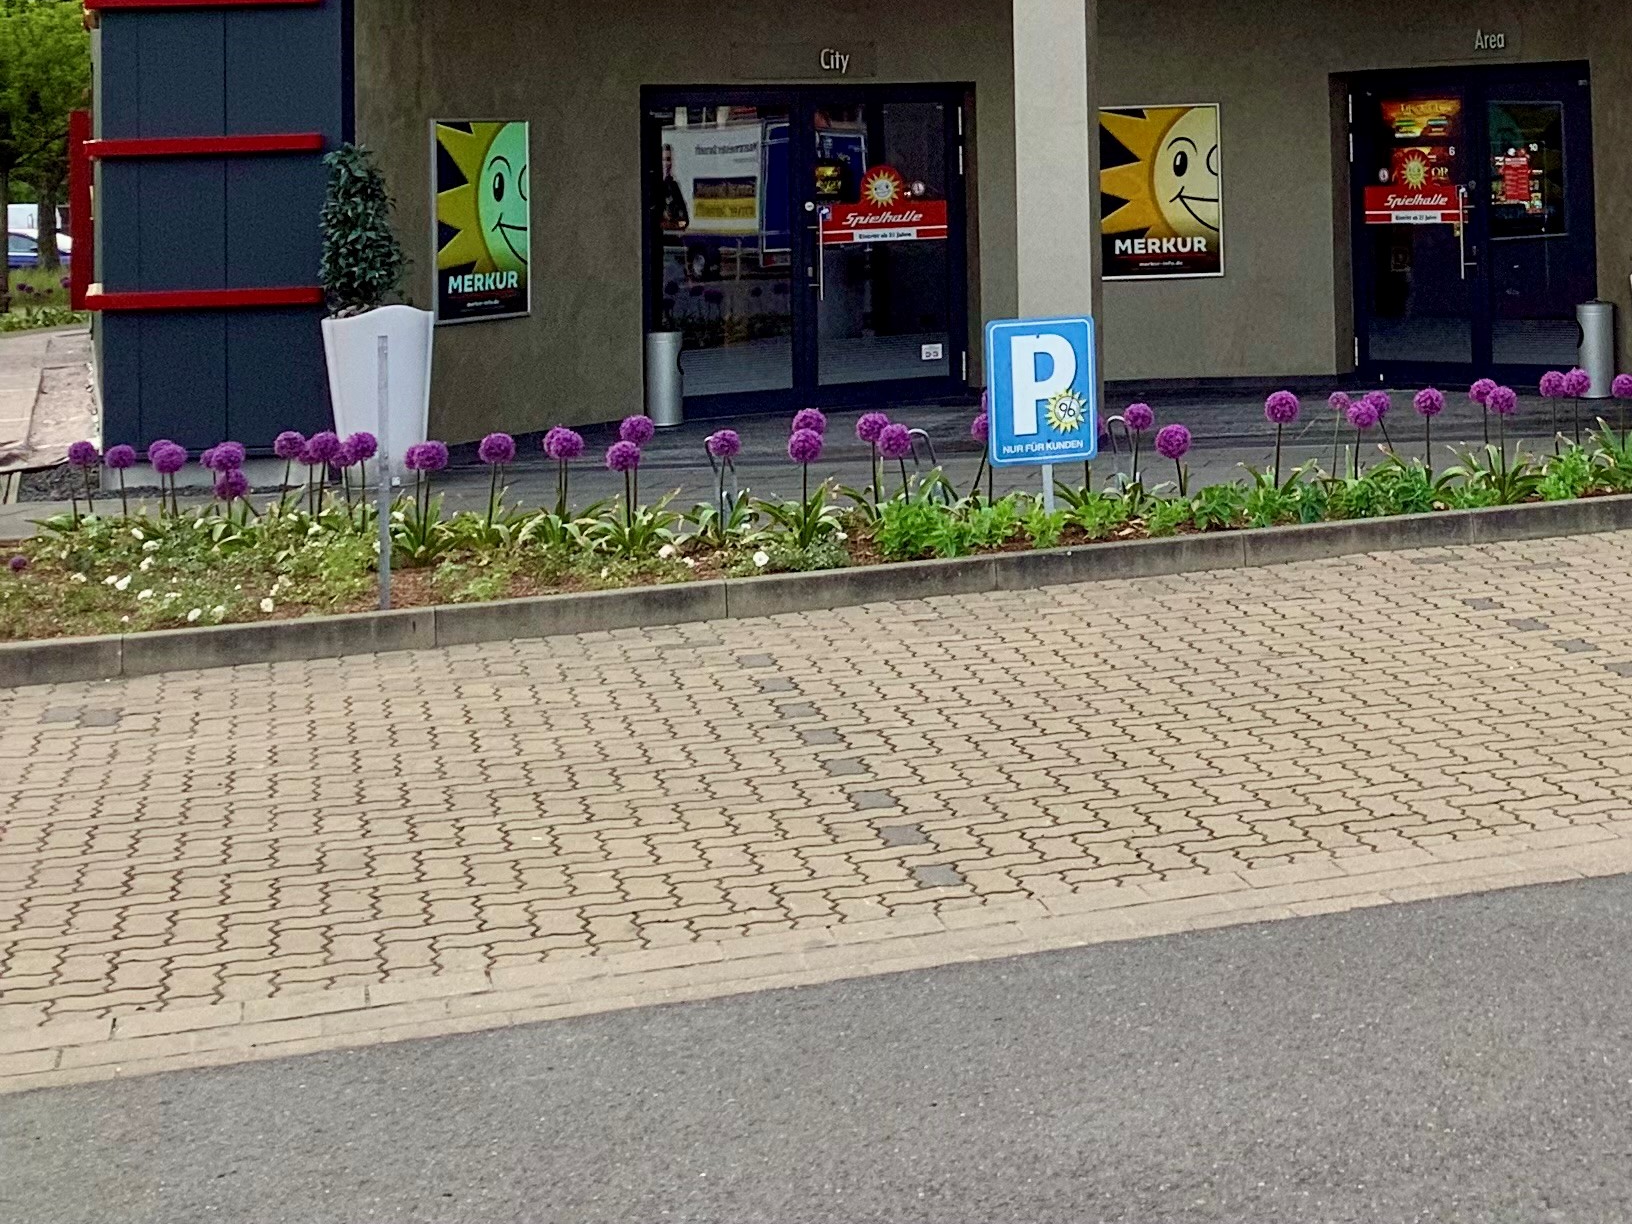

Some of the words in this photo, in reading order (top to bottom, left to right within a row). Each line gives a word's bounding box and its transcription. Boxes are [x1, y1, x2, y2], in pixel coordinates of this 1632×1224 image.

[1474, 28, 1505, 50] Area
[820, 48, 850, 74] City
[1384, 193, 1448, 209] Spielhalle
[842, 210, 923, 228] Spielhalle
[1114, 237, 1207, 255] MERKUR
[447, 271, 518, 294] MERKUR
[1011, 333, 1077, 436] P
[1002, 444, 1024, 455] NUR
[1025, 442, 1045, 453] FÜR
[1046, 440, 1084, 452] KUNDEN
